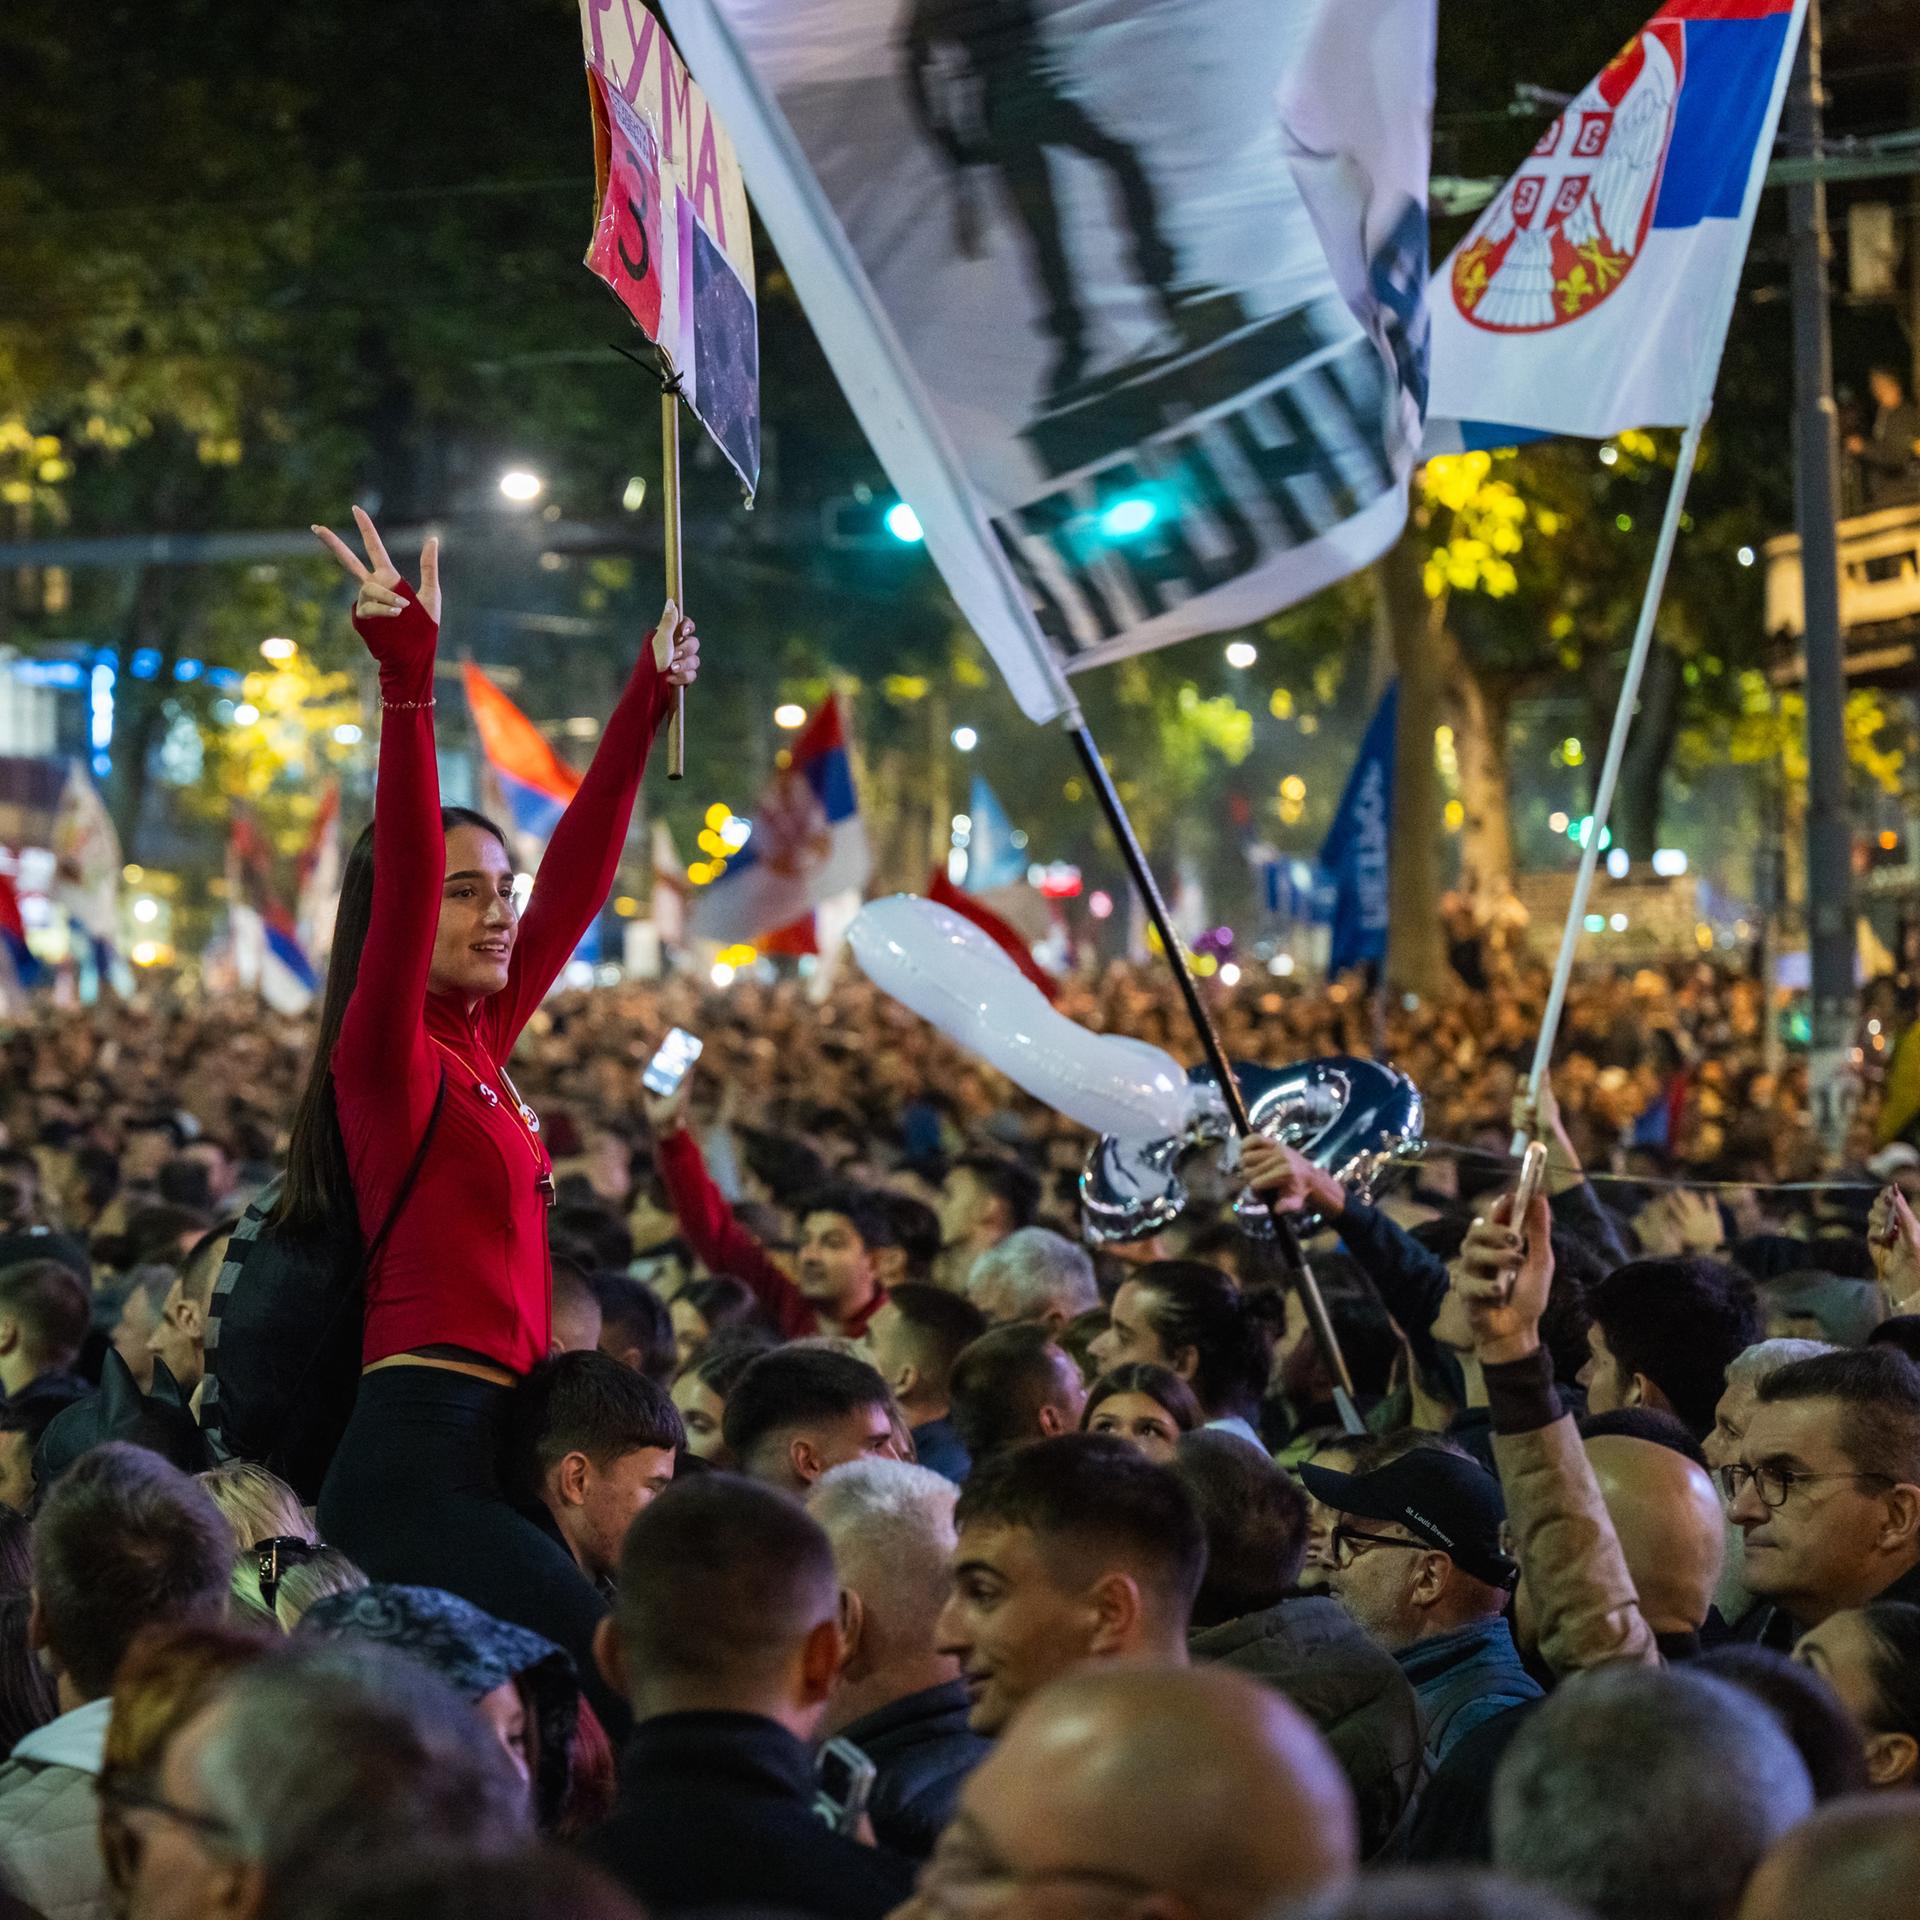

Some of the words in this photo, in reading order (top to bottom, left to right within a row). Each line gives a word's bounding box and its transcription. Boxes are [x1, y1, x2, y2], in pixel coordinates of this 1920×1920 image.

[480, 1083, 498, 1104] 3
[1413, 1512, 1431, 1528] Louis
[1430, 1523, 1455, 1547] Brewery
